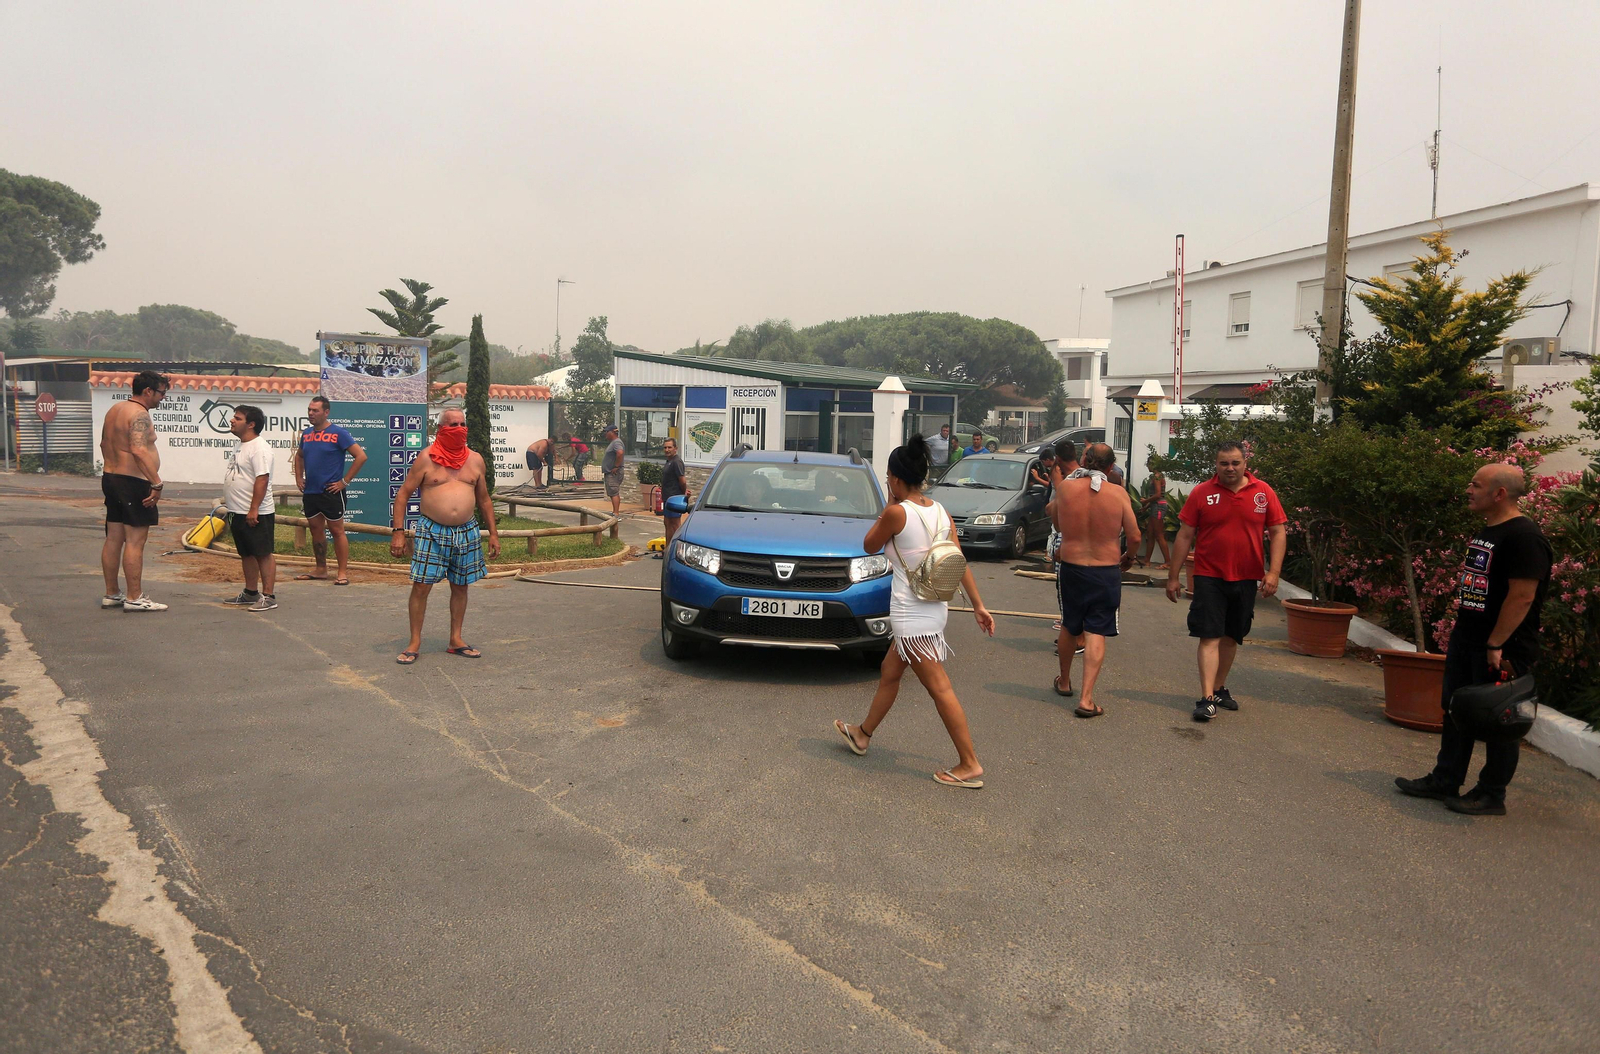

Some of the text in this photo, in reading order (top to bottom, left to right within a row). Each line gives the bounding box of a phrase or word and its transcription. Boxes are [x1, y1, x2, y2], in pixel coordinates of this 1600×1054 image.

[330, 340, 384, 355] CAMPING
[342, 354, 358, 364] DE
[733, 387, 776, 397] RECEPCIÓN
[38, 402, 56, 412] STOP
[153, 413, 192, 422] SEGURIDAD
[154, 425, 199, 433] RGANIZACION
[303, 431, 338, 444] adidas
[266, 440, 291, 448] ERCADO
[1206, 493, 1220, 505] 57
[752, 600, 820, 616] 2801 JKB
